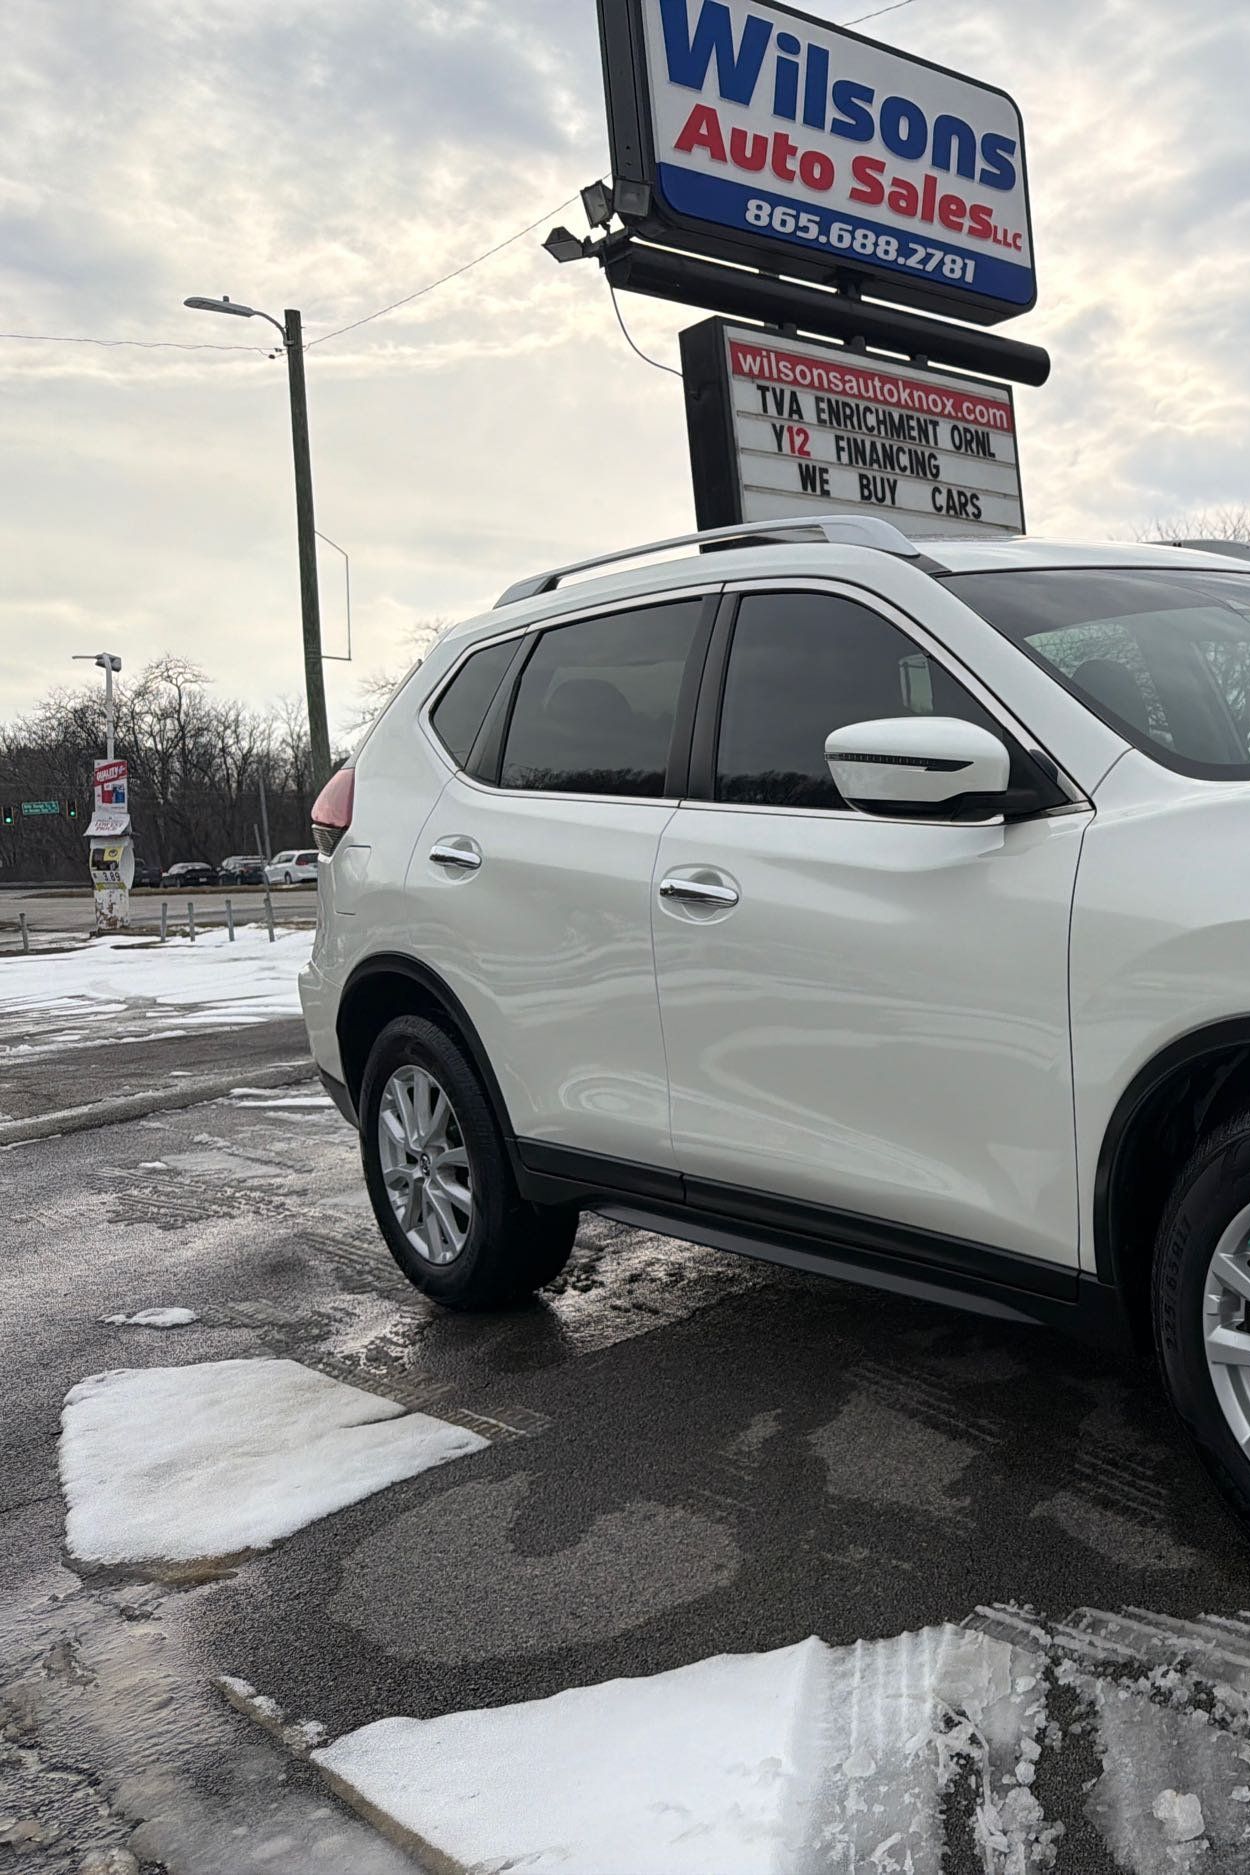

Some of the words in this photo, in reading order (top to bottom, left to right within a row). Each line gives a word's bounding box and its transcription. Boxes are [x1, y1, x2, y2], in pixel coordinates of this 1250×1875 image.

[659, 0, 1017, 191] Wilsons
[673, 103, 835, 192] Auto
[848, 155, 994, 240] Sales
[992, 223, 1023, 252] LLC
[744, 198, 976, 285] 865.688.2781
[737, 351, 1008, 430] wilsonsautoknox.com
[756, 385, 804, 420] TVA
[815, 397, 940, 447] ENRICHMENT
[950, 425, 996, 459] ORNL
[771, 423, 812, 457] Y12
[834, 434, 940, 480] FINANCING
[799, 463, 831, 498] WE
[859, 473, 898, 506] BUY
[931, 486, 982, 521] CARS
